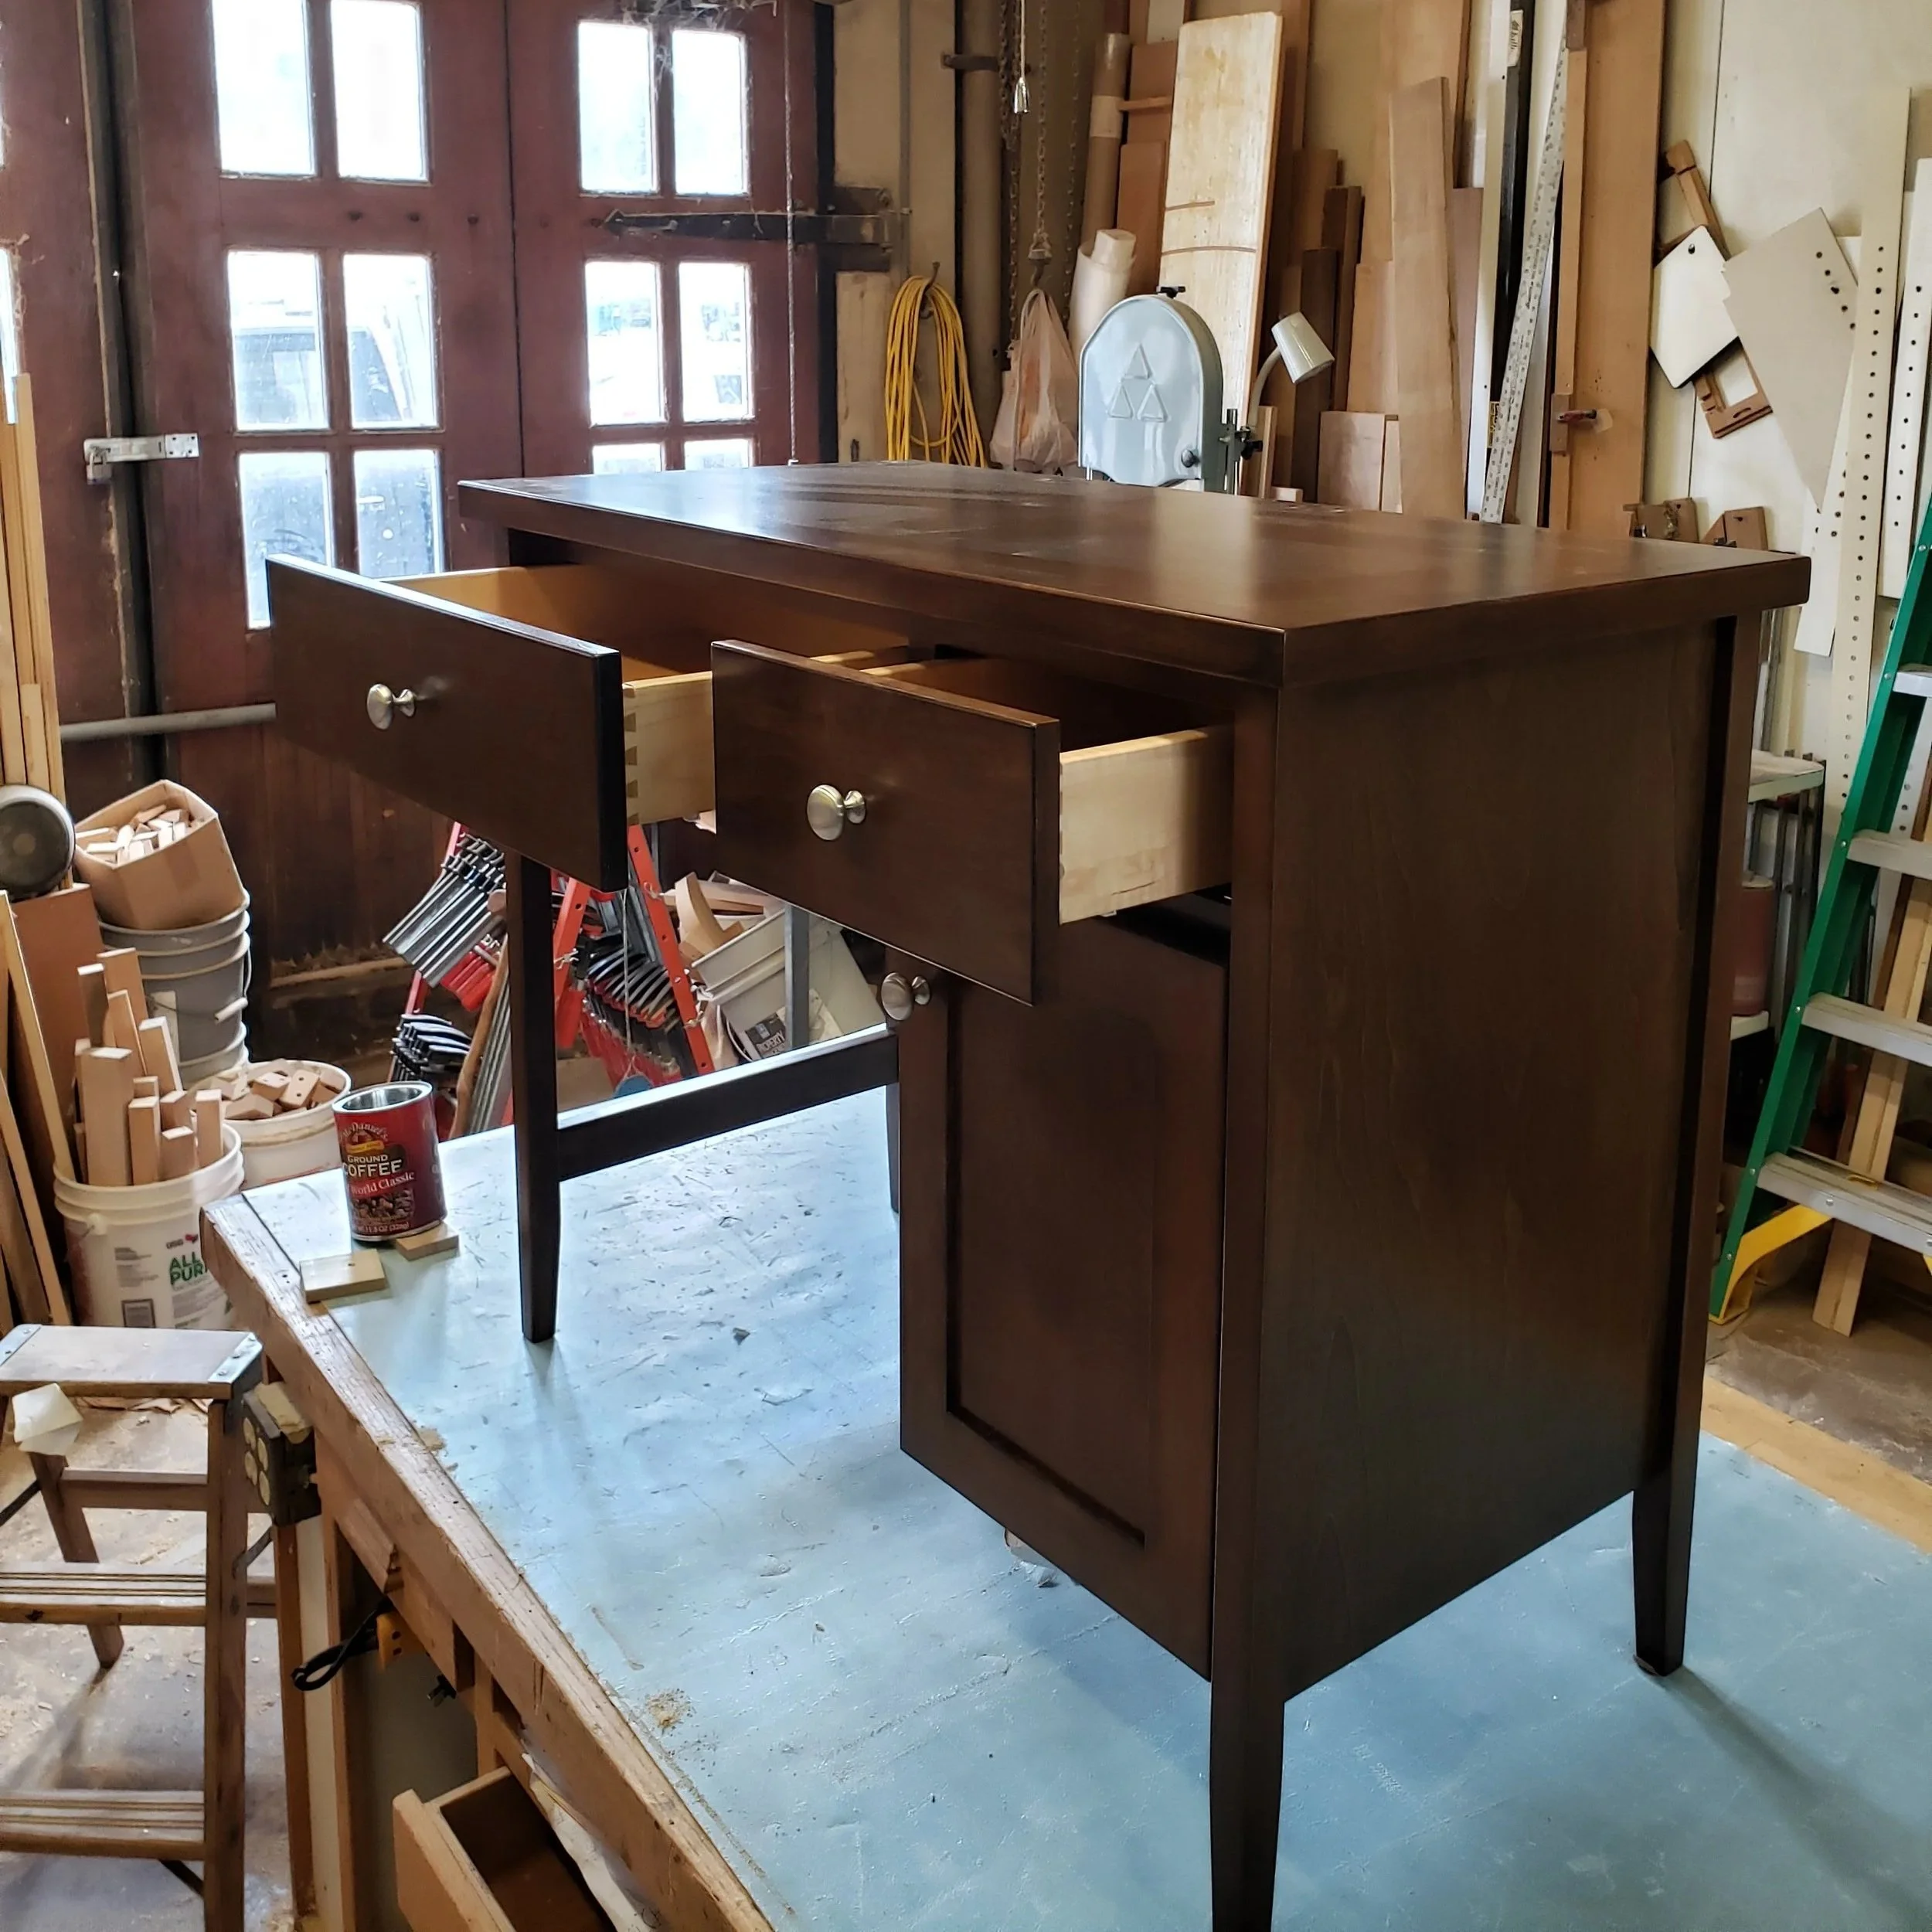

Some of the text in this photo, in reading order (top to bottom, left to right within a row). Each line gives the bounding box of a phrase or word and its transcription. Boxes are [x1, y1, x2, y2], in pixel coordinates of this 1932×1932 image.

[757, 1029, 785, 1053] PROPERTY
[347, 1155, 388, 1164] GROUND
[351, 1172, 415, 1195] World Classic
[171, 1251, 201, 1269] ALL
[170, 1260, 208, 1284] PUR
